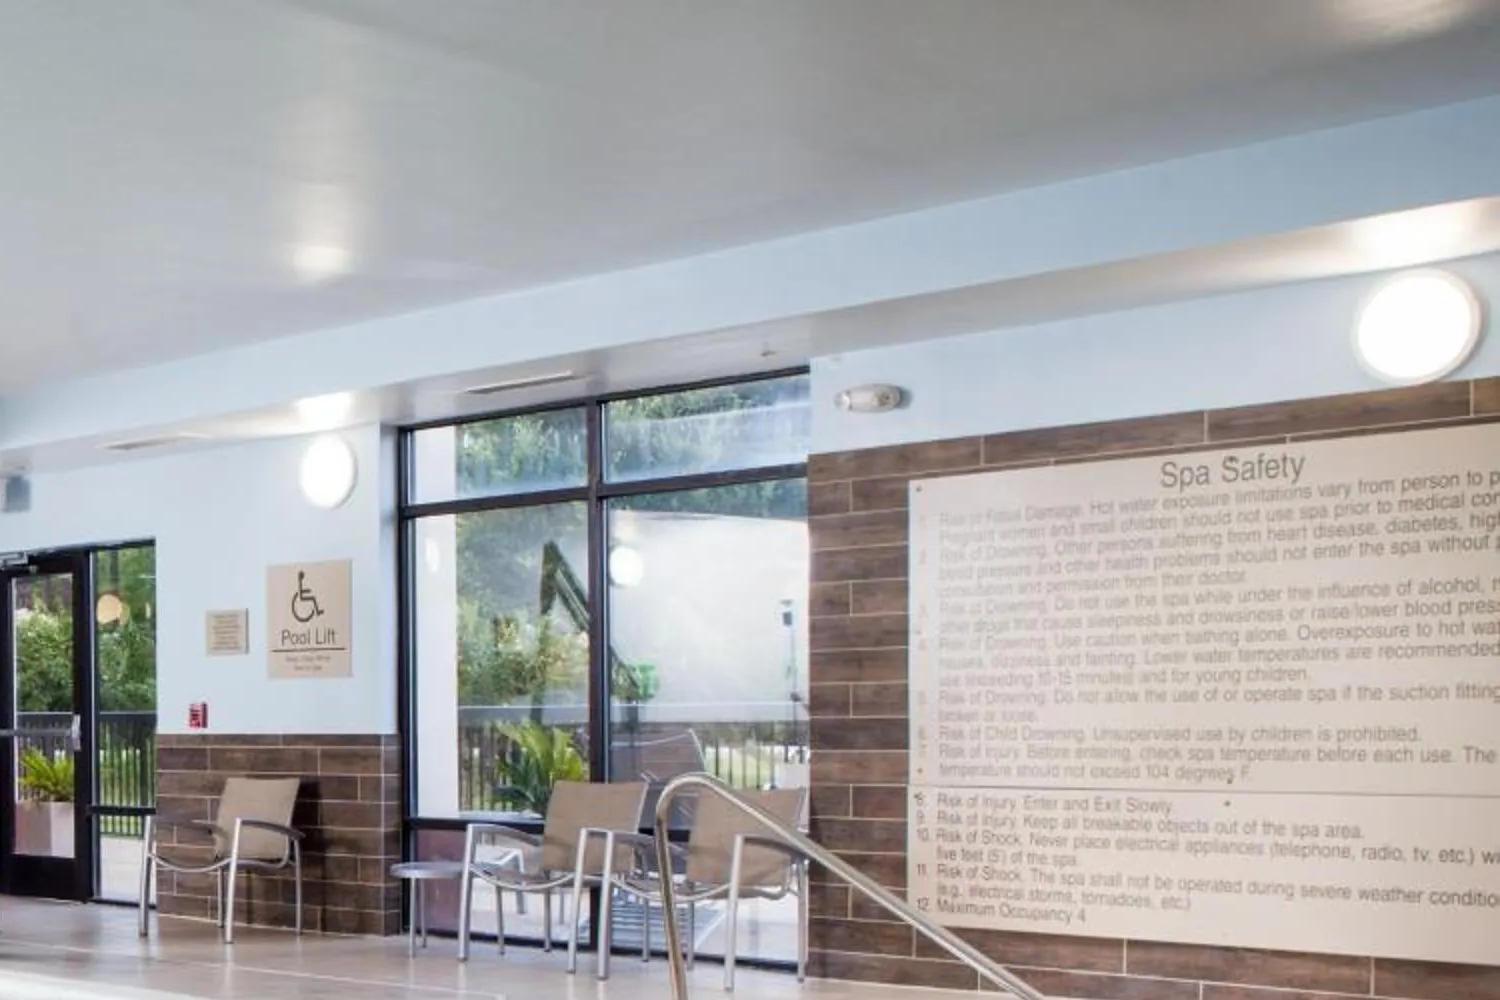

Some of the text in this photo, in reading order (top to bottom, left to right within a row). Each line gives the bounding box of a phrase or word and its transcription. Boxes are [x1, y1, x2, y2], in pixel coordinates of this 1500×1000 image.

[1160, 449, 1306, 493] Spa Safety
[1235, 484, 1312, 504] limitations
[1317, 481, 1351, 498] vary
[1358, 477, 1394, 494] from
[1401, 471, 1460, 494] person
[1183, 510, 1232, 527] should
[1236, 508, 1259, 523] not
[1265, 507, 1293, 521] use
[1299, 505, 1328, 521] spa
[1334, 500, 1370, 519] prior
[1397, 492, 1464, 512] medical
[1227, 529, 1261, 544] from
[1267, 523, 1308, 541] heart
[1225, 547, 1277, 564] should
[1282, 545, 1307, 561] not
[1313, 543, 1352, 559] enter
[1358, 540, 1384, 556] the
[1389, 540, 1421, 557] spa
[1426, 533, 1490, 552] without
[1193, 589, 1233, 605] while
[1238, 587, 1283, 603] under
[1317, 583, 1390, 600] influence
[1418, 576, 1483, 595] alcohol,
[1197, 607, 1283, 624] drowsiness
[1310, 604, 1349, 620] raise
[1404, 598, 1451, 616] blood
[281, 627, 336, 646] Pool Lift
[1297, 622, 1410, 642] Overexposure
[1437, 618, 1465, 636] hot
[1192, 648, 1229, 663] water
[1238, 646, 1339, 664] temperatures
[1345, 646, 1372, 659] are
[1195, 671, 1240, 686] young
[1243, 685, 1303, 704] operate
[1308, 687, 1336, 704] spa
[1356, 684, 1383, 700] the
[1388, 683, 1450, 700] suction
[1195, 727, 1222, 741] use
[1251, 725, 1313, 741] children
[1336, 724, 1422, 744] prohibited.
[1187, 747, 1214, 763] spa
[1220, 745, 1310, 763] temperature
[1317, 745, 1367, 762] before
[1373, 746, 1414, 762] each
[1461, 746, 1497, 763] The
[1145, 765, 1168, 779] 104
[1023, 794, 1057, 810] Enter
[1063, 796, 1088, 811] and
[1094, 796, 1121, 812] Exit
[1023, 813, 1058, 830] Keep
[1157, 817, 1208, 835] objects
[1214, 819, 1238, 834] out
[1262, 820, 1285, 836] the
[1291, 823, 1319, 840] spa
[1324, 824, 1365, 839] area.
[1030, 831, 1067, 847] Never
[1073, 833, 1110, 850] place
[1114, 835, 1179, 851] electrical
[1184, 838, 1263, 856] appliances
[1269, 840, 1355, 861] (telephone,
[1361, 844, 1407, 863] radio,
[1438, 847, 1473, 867] etc.)
[1029, 868, 1055, 883] The
[1059, 872, 1085, 887] spa
[1089, 872, 1122, 887] shall
[1127, 874, 1149, 889] not
[1177, 878, 1242, 894] operated
[1247, 879, 1294, 900] during
[1300, 884, 1351, 900] severe
[1357, 887, 1422, 904] weather
[936, 898, 995, 915] Maximum
[999, 902, 1072, 923] Occupancy
